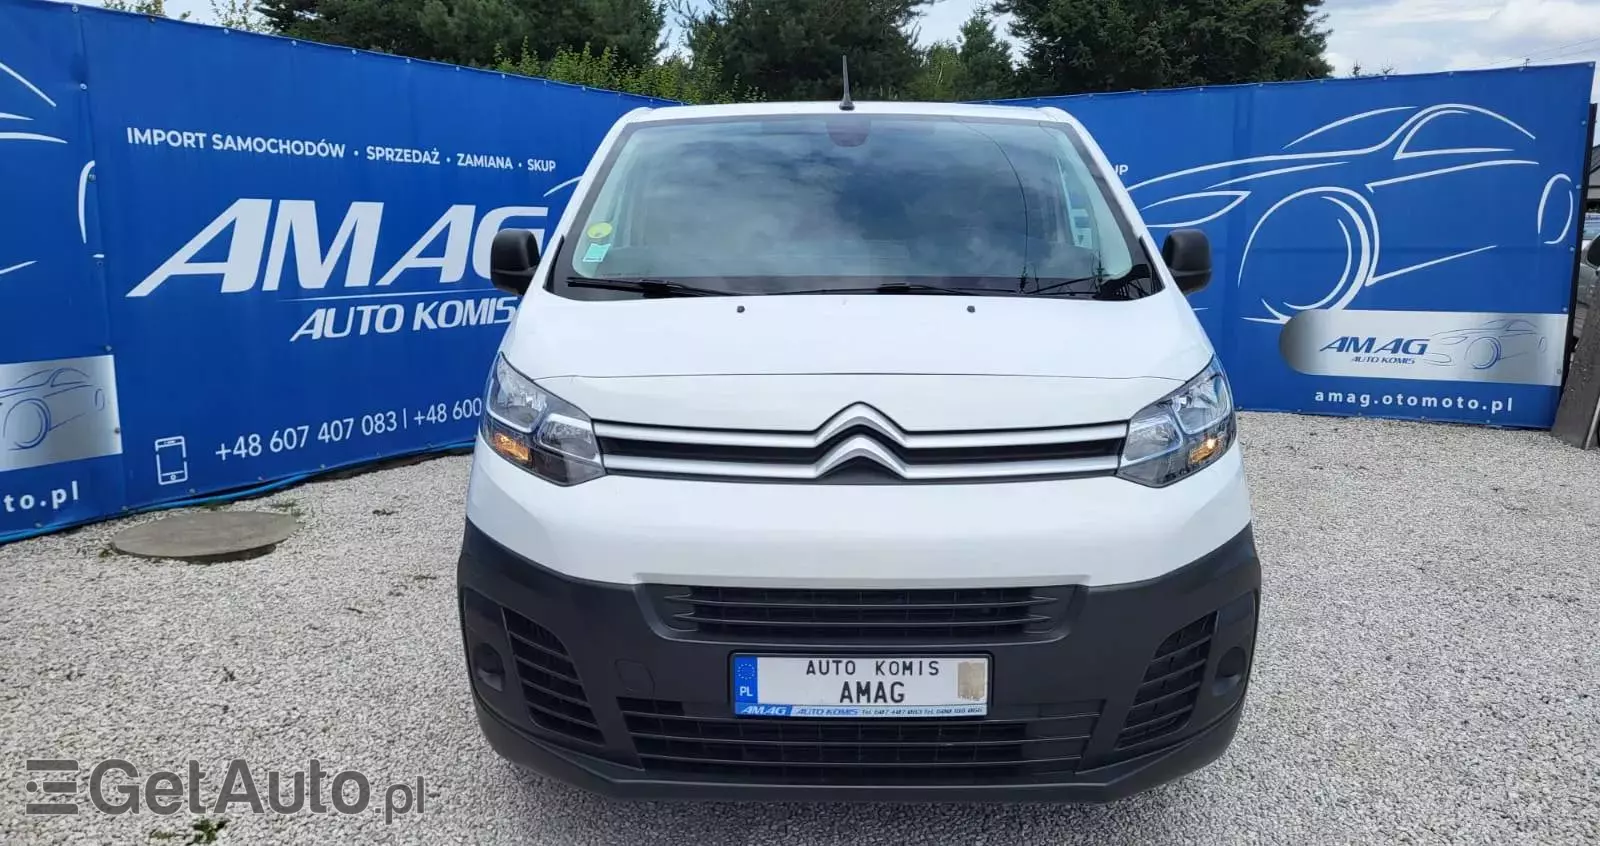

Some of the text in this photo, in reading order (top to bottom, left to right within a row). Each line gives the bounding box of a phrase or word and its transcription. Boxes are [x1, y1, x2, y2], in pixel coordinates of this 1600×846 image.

[126, 126, 557, 172] IMPORT SAMOCHODÓW SPRZEDAŻ ZAMIANA SKUP
[289, 296, 518, 342] AUTO KOMIS
[1351, 355, 1380, 364] AUTO
[1314, 391, 1513, 414] amag.otomoto.pl
[215, 397, 482, 461] +48 607 407 083 +48 600
[805, 659, 940, 677] AUTO KOMIS
[739, 686, 754, 697] PL
[839, 680, 905, 704] AMAG
[797, 707, 824, 716] AUTO
